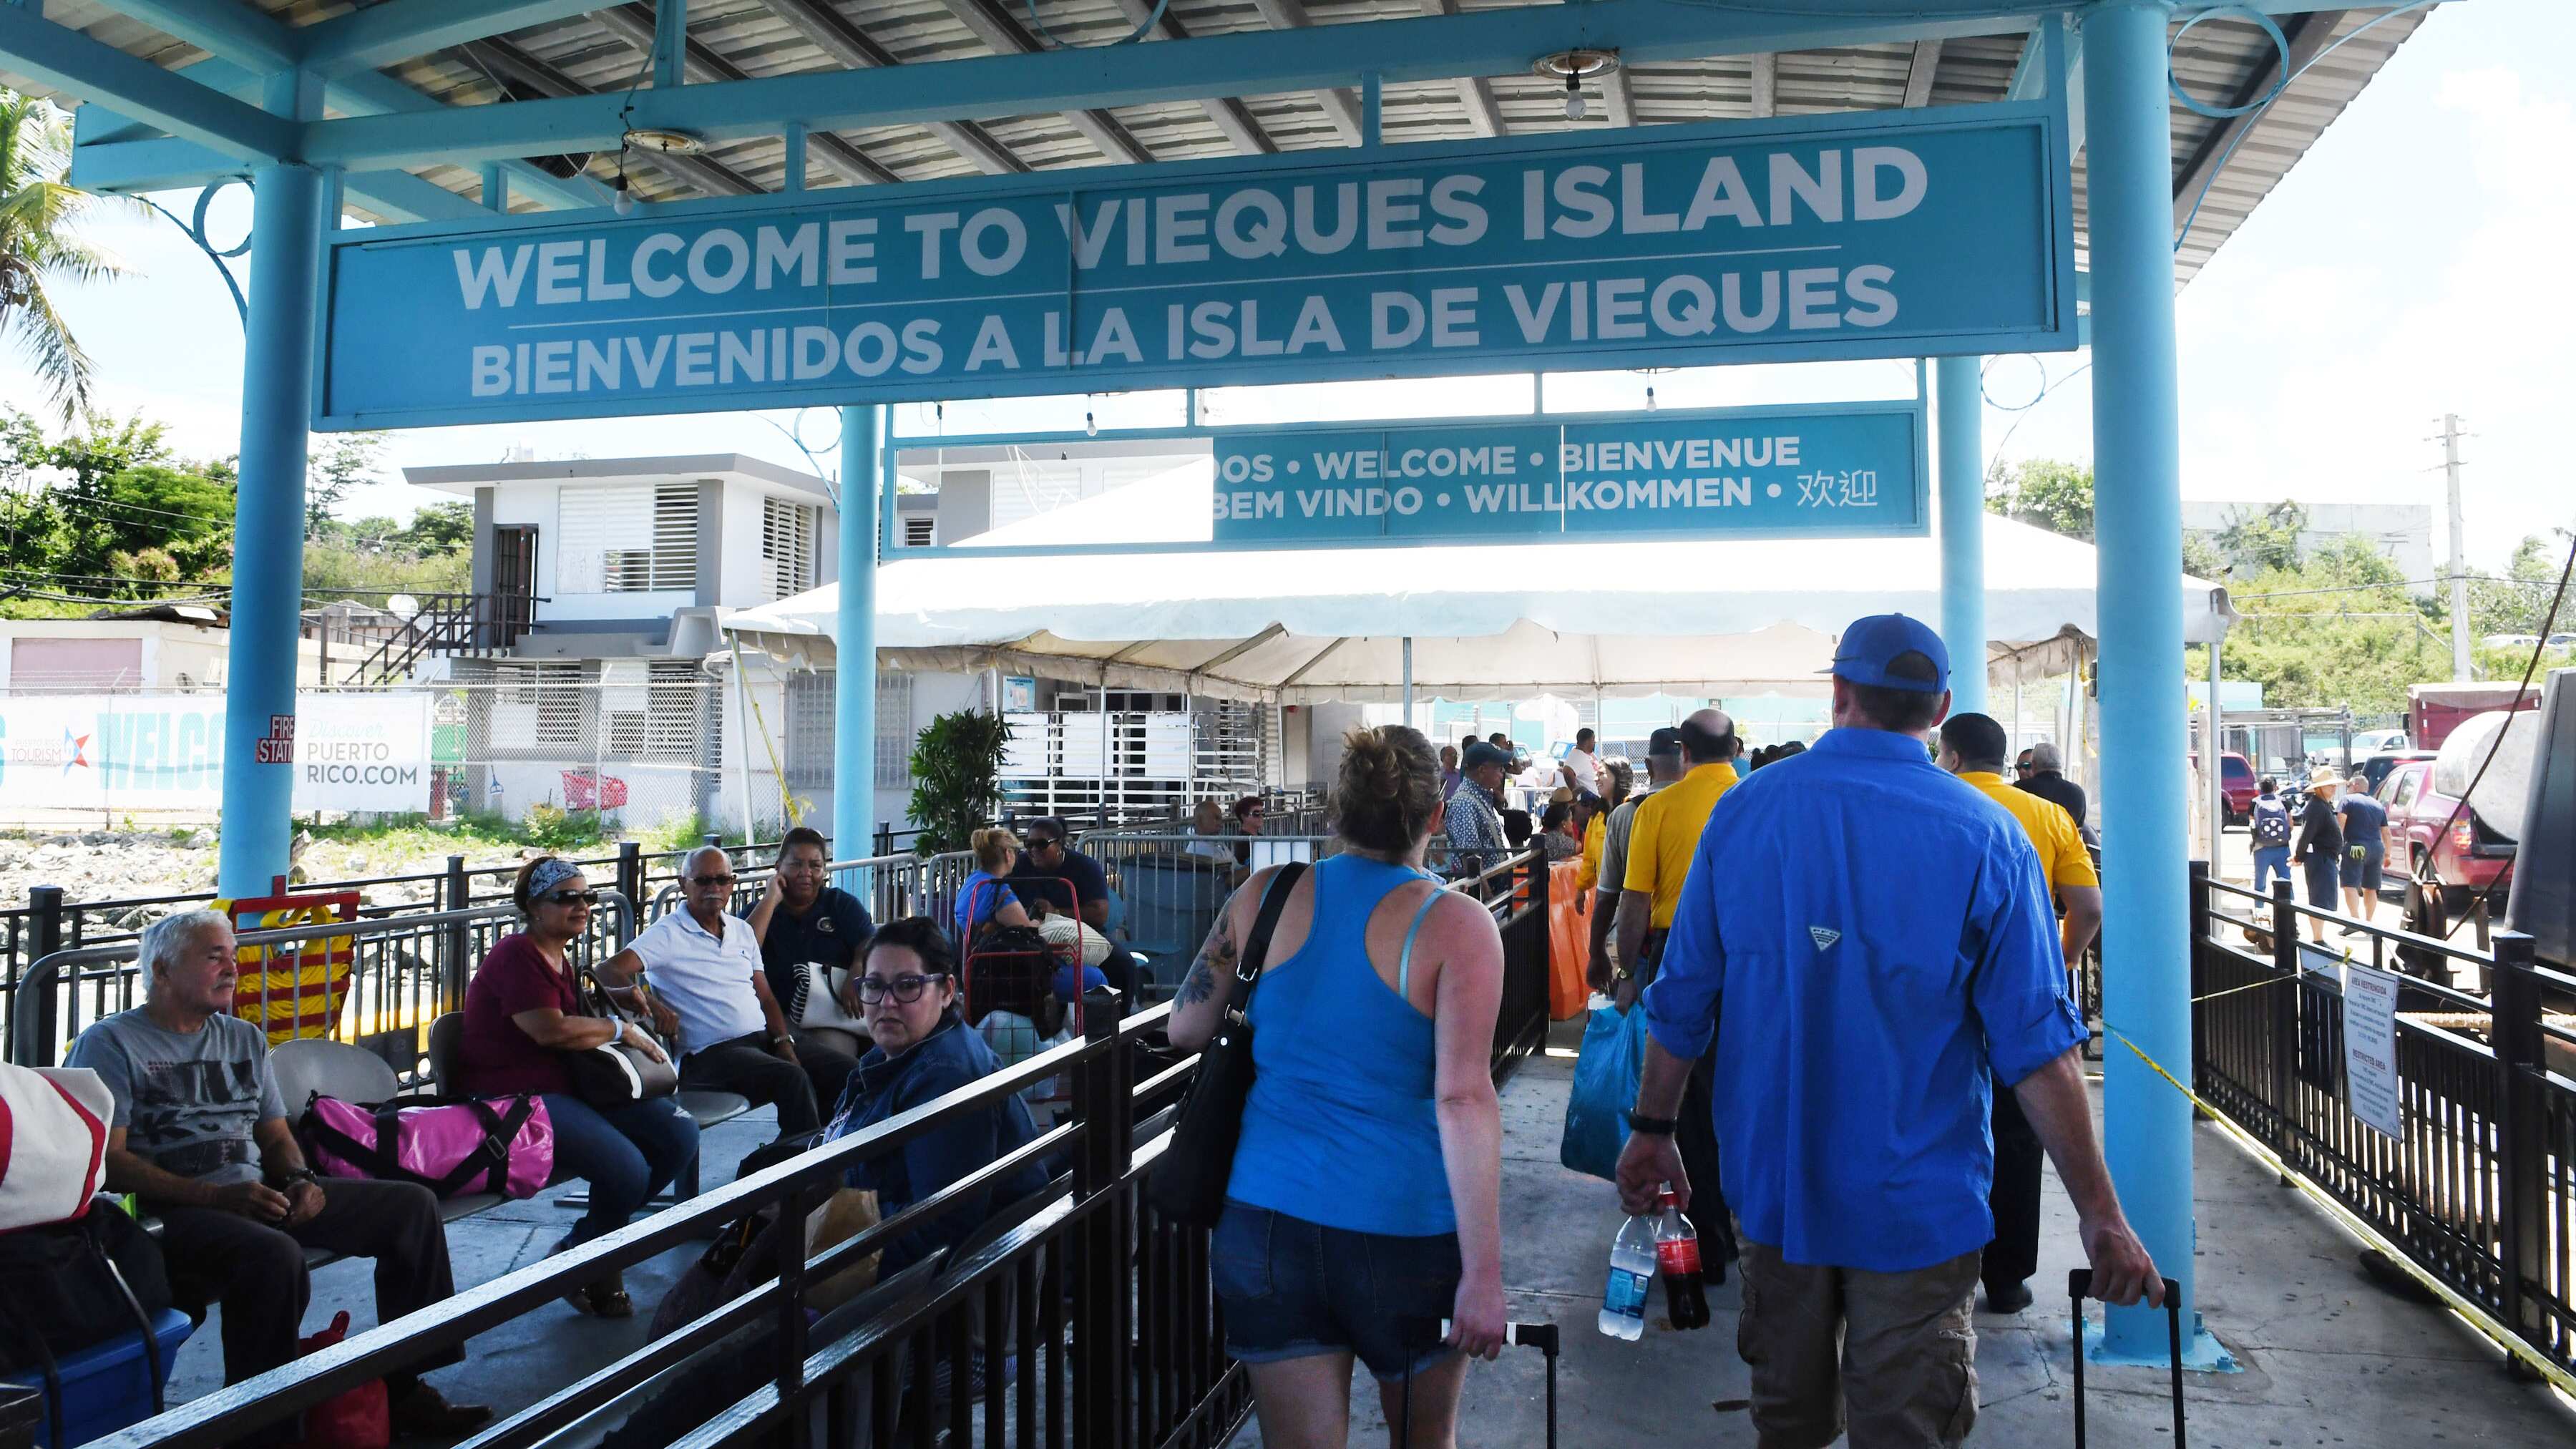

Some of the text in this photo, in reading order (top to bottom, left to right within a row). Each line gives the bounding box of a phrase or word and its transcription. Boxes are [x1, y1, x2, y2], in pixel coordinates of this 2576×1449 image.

[453, 146, 1928, 310] WELCOME TO VIEQUES ISLAND
[472, 265, 1898, 397] BIENVENIDOS A LA ISLA DE VIEQUES
[1214, 436, 1800, 483] OS WELCOME BIENVENUE
[1214, 477, 1752, 519] BEM VINDO WILLKOMMEN
[1797, 469, 1878, 508] 欢迎
[272, 716, 294, 739] FIRE
[308, 721, 384, 738] Discover
[11, 748, 62, 762] TOURISM
[97, 712, 227, 791] WELCO
[259, 738, 294, 763] STATI
[307, 742, 390, 762] PUERTO
[307, 764, 418, 786] RICO.COM
